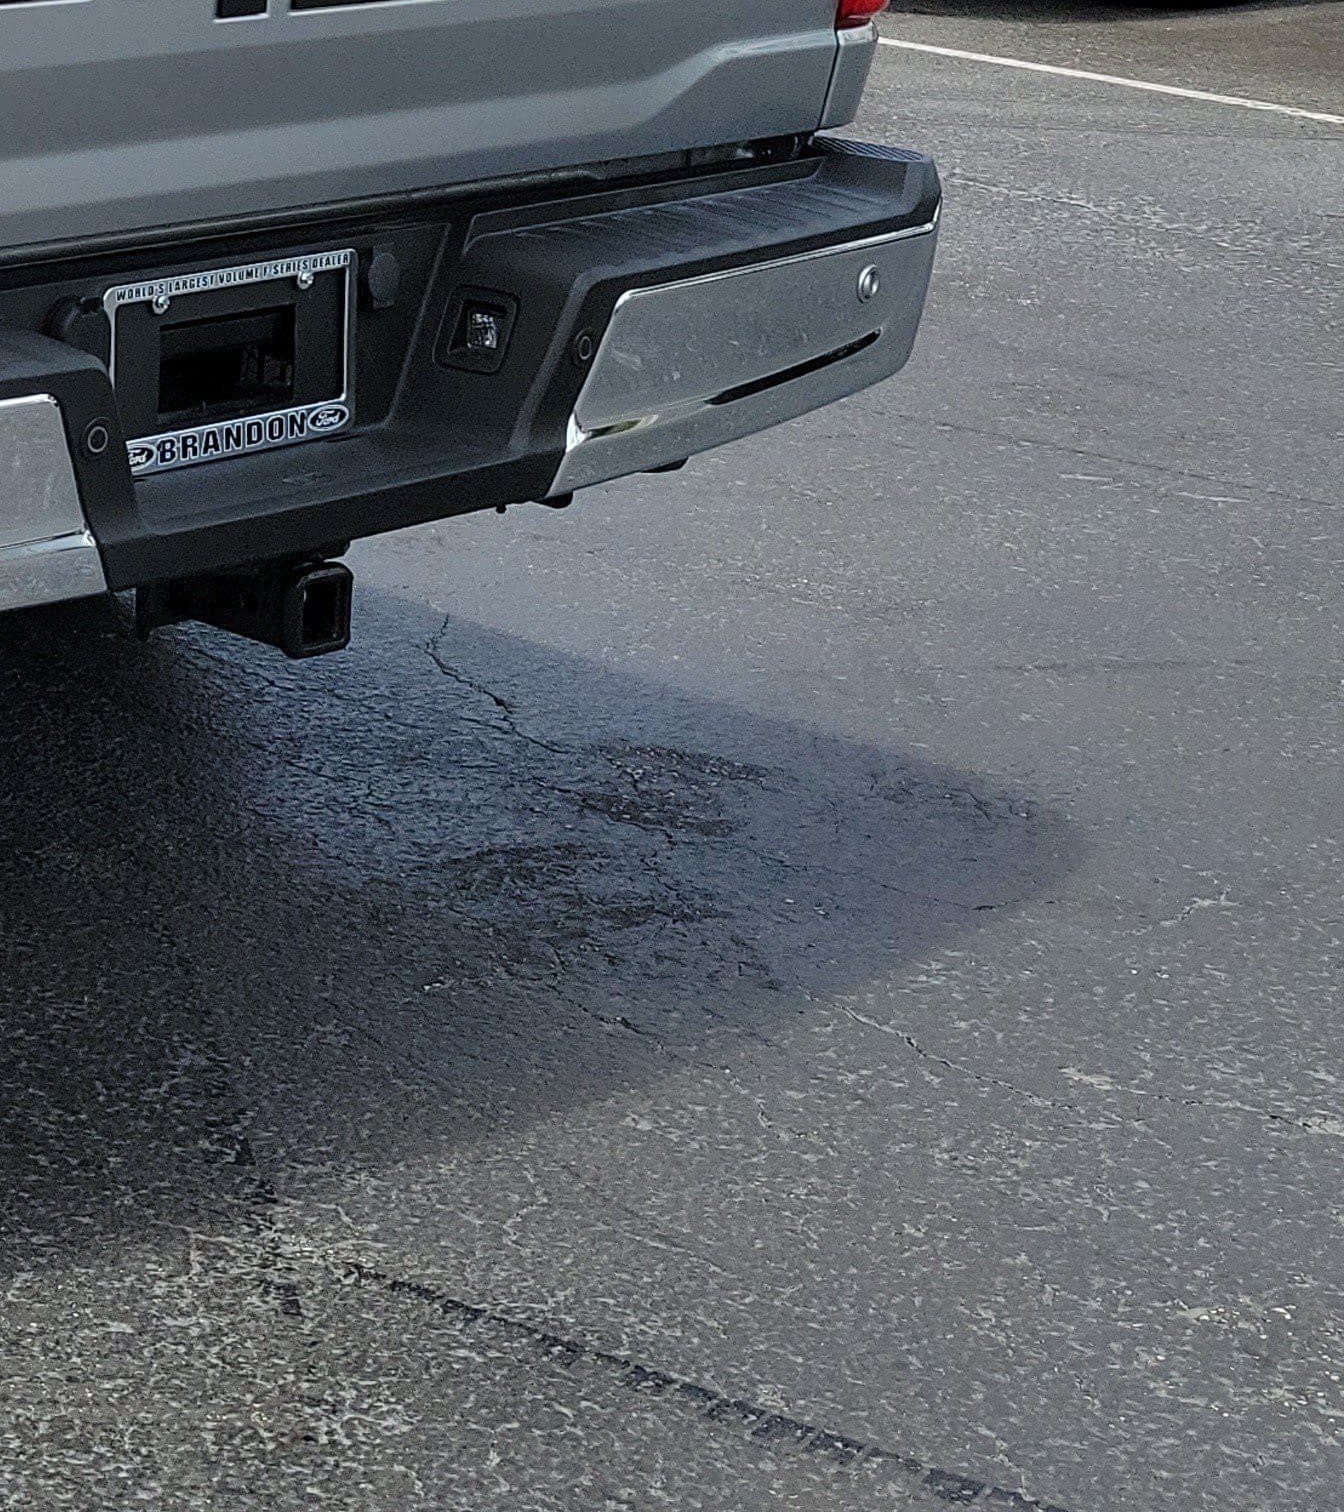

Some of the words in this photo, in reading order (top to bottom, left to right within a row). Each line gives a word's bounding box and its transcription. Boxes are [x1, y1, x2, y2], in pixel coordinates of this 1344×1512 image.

[168, 275, 214, 293] LARGEST
[218, 269, 259, 285] VOLUME
[311, 253, 349, 269] DEALER
[157, 409, 307, 465] BRANDON
[315, 410, 342, 427] Ford
